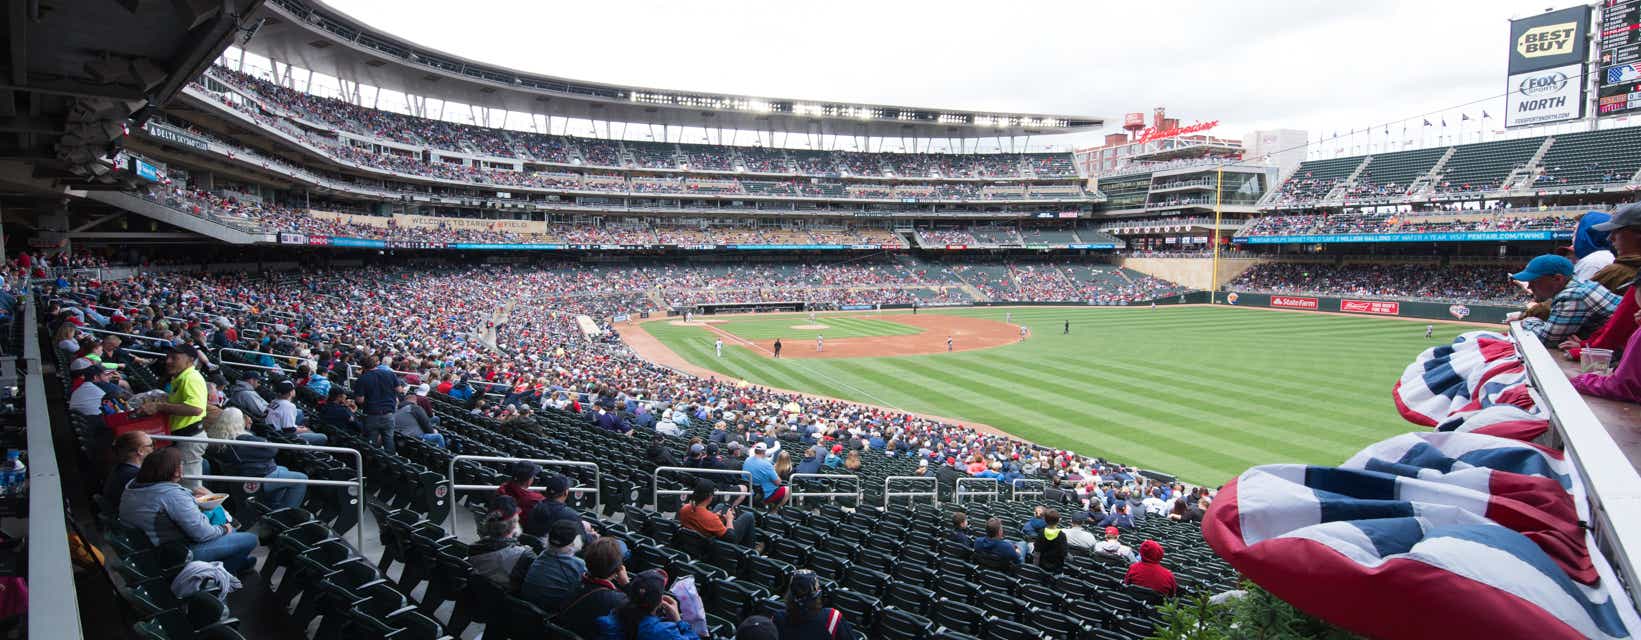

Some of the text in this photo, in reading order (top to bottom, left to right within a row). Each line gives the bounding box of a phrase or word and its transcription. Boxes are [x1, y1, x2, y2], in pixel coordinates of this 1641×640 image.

[1525, 28, 1575, 43] BEST
[1525, 39, 1569, 53] BUY
[1529, 74, 1557, 88] FOX
[1528, 85, 1559, 93] SPORTS
[1518, 96, 1567, 112] NORTH
[156, 128, 176, 140] DELTA
[1137, 120, 1220, 144] Budweiser
[412, 217, 451, 226] WELCOME
